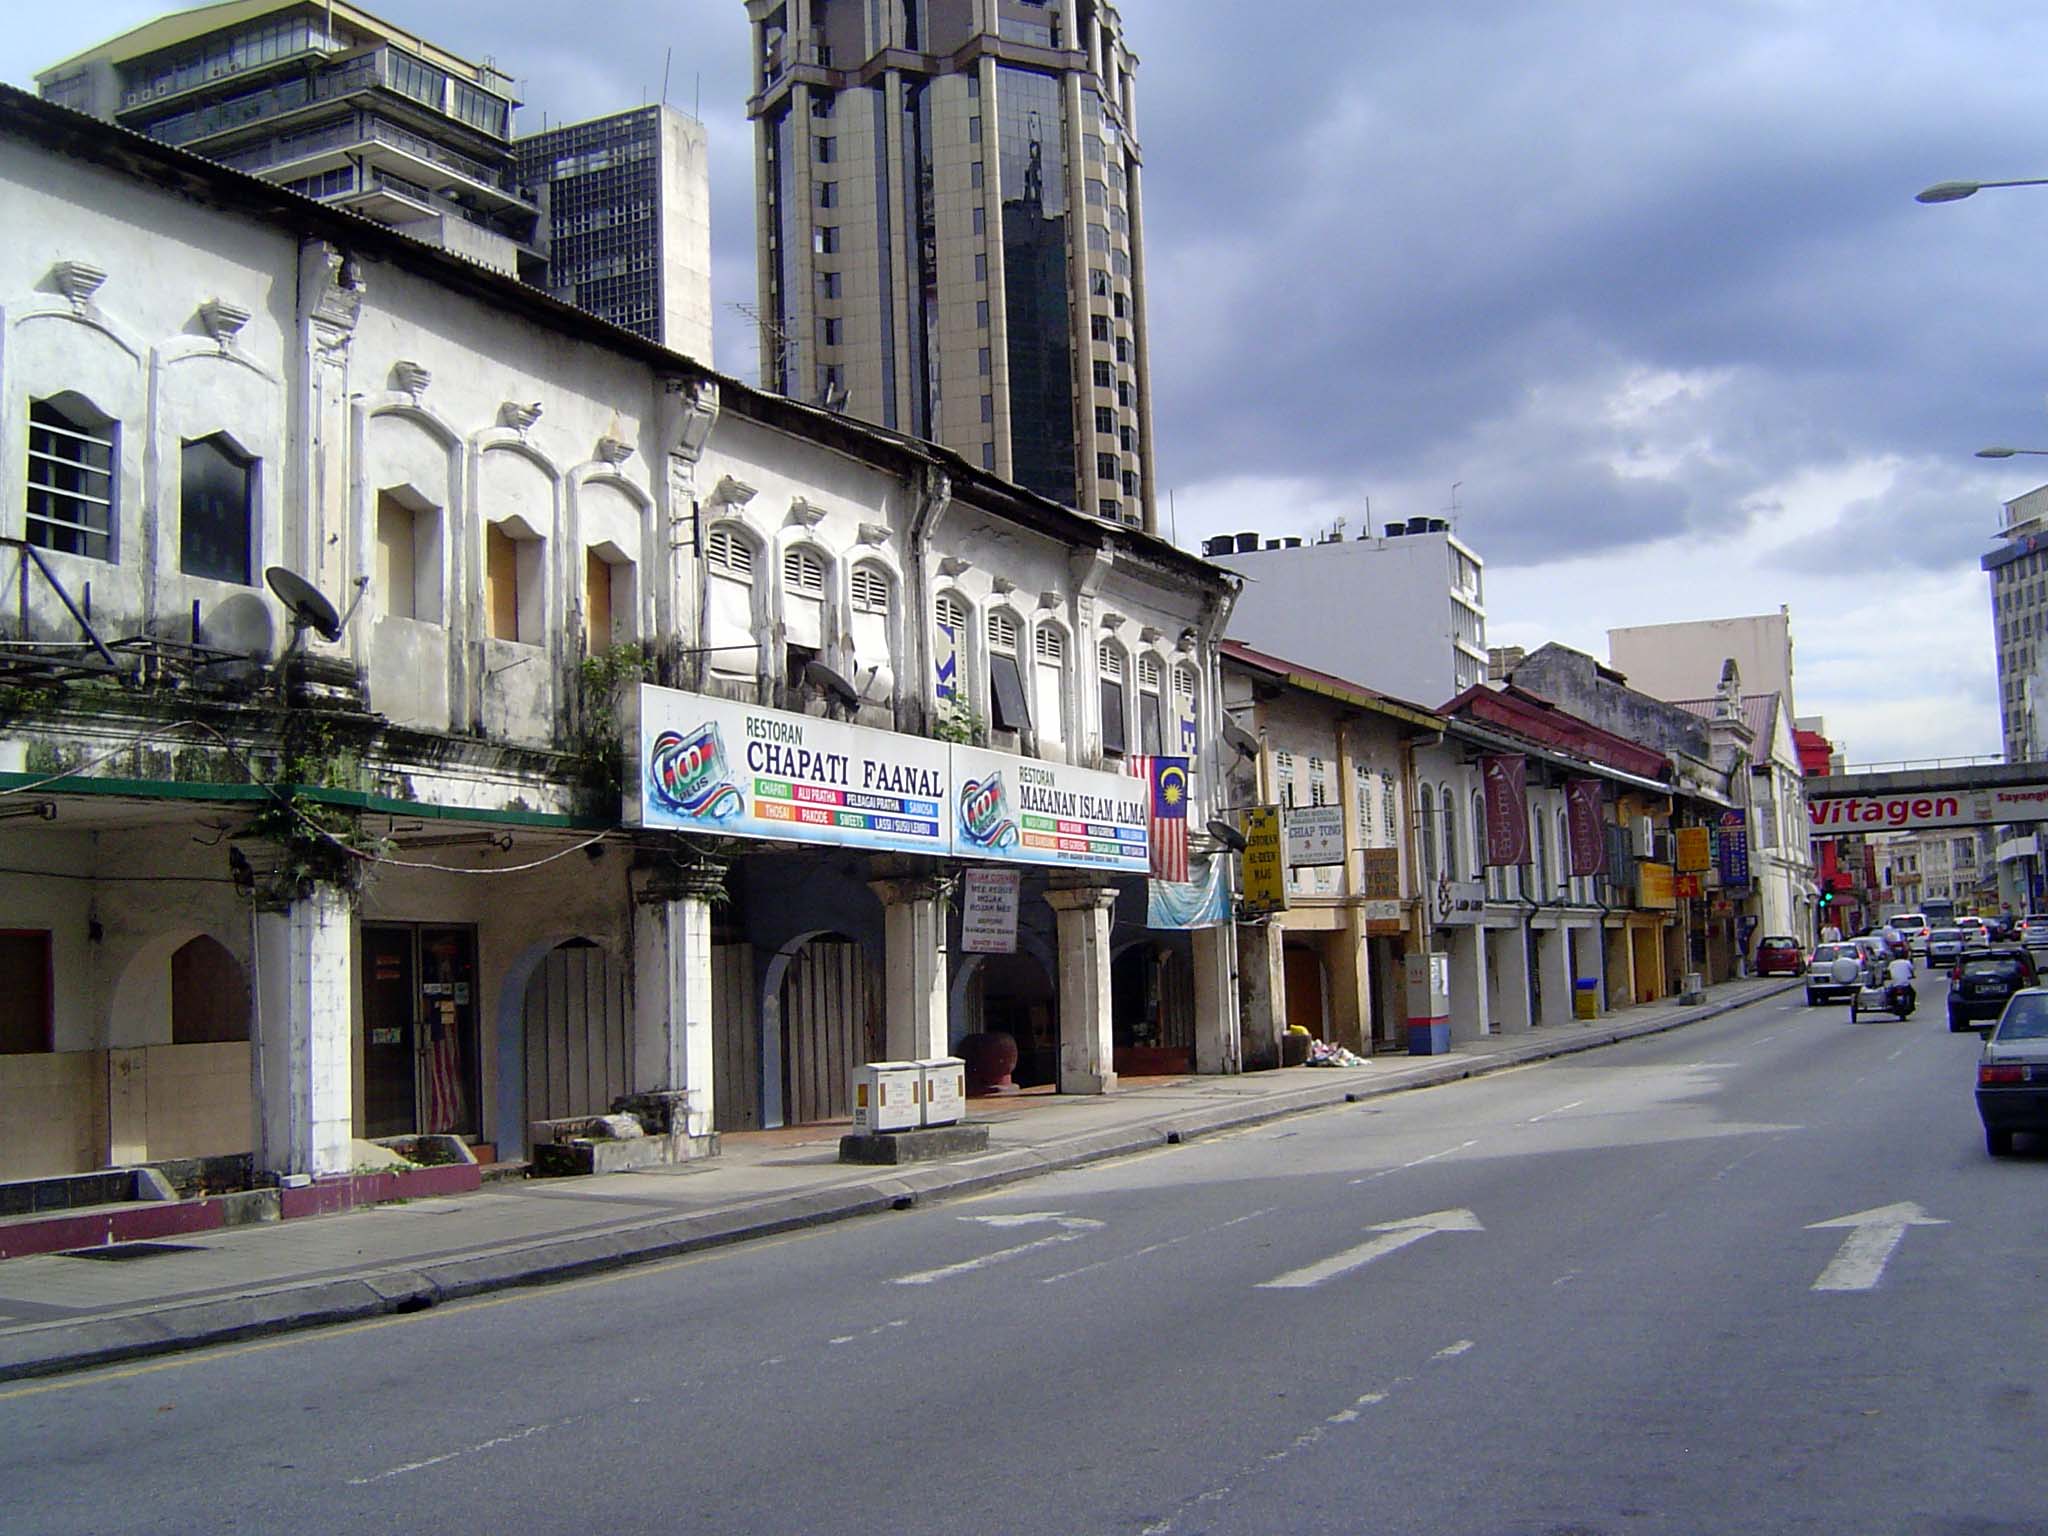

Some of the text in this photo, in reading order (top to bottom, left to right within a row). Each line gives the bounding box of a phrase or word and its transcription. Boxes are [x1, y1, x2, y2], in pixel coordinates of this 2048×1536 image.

[746, 716, 803, 746] RESTORAN
[670, 745, 702, 790] 100
[747, 741, 944, 798] CHAPATI FAANAL
[1018, 765, 1055, 787] RESTORAN
[680, 777, 709, 802] PLUS
[760, 781, 787, 797] CHAPATI
[798, 787, 811, 801] ALU
[811, 788, 837, 804] PRATHA
[876, 797, 900, 812] PRATHA
[1019, 784, 1147, 826] MAKANAN ISLAM ALMA
[765, 804, 790, 819] THOSAI
[840, 813, 864, 828] SWEETS
[1808, 796, 1959, 827] Vitagen
